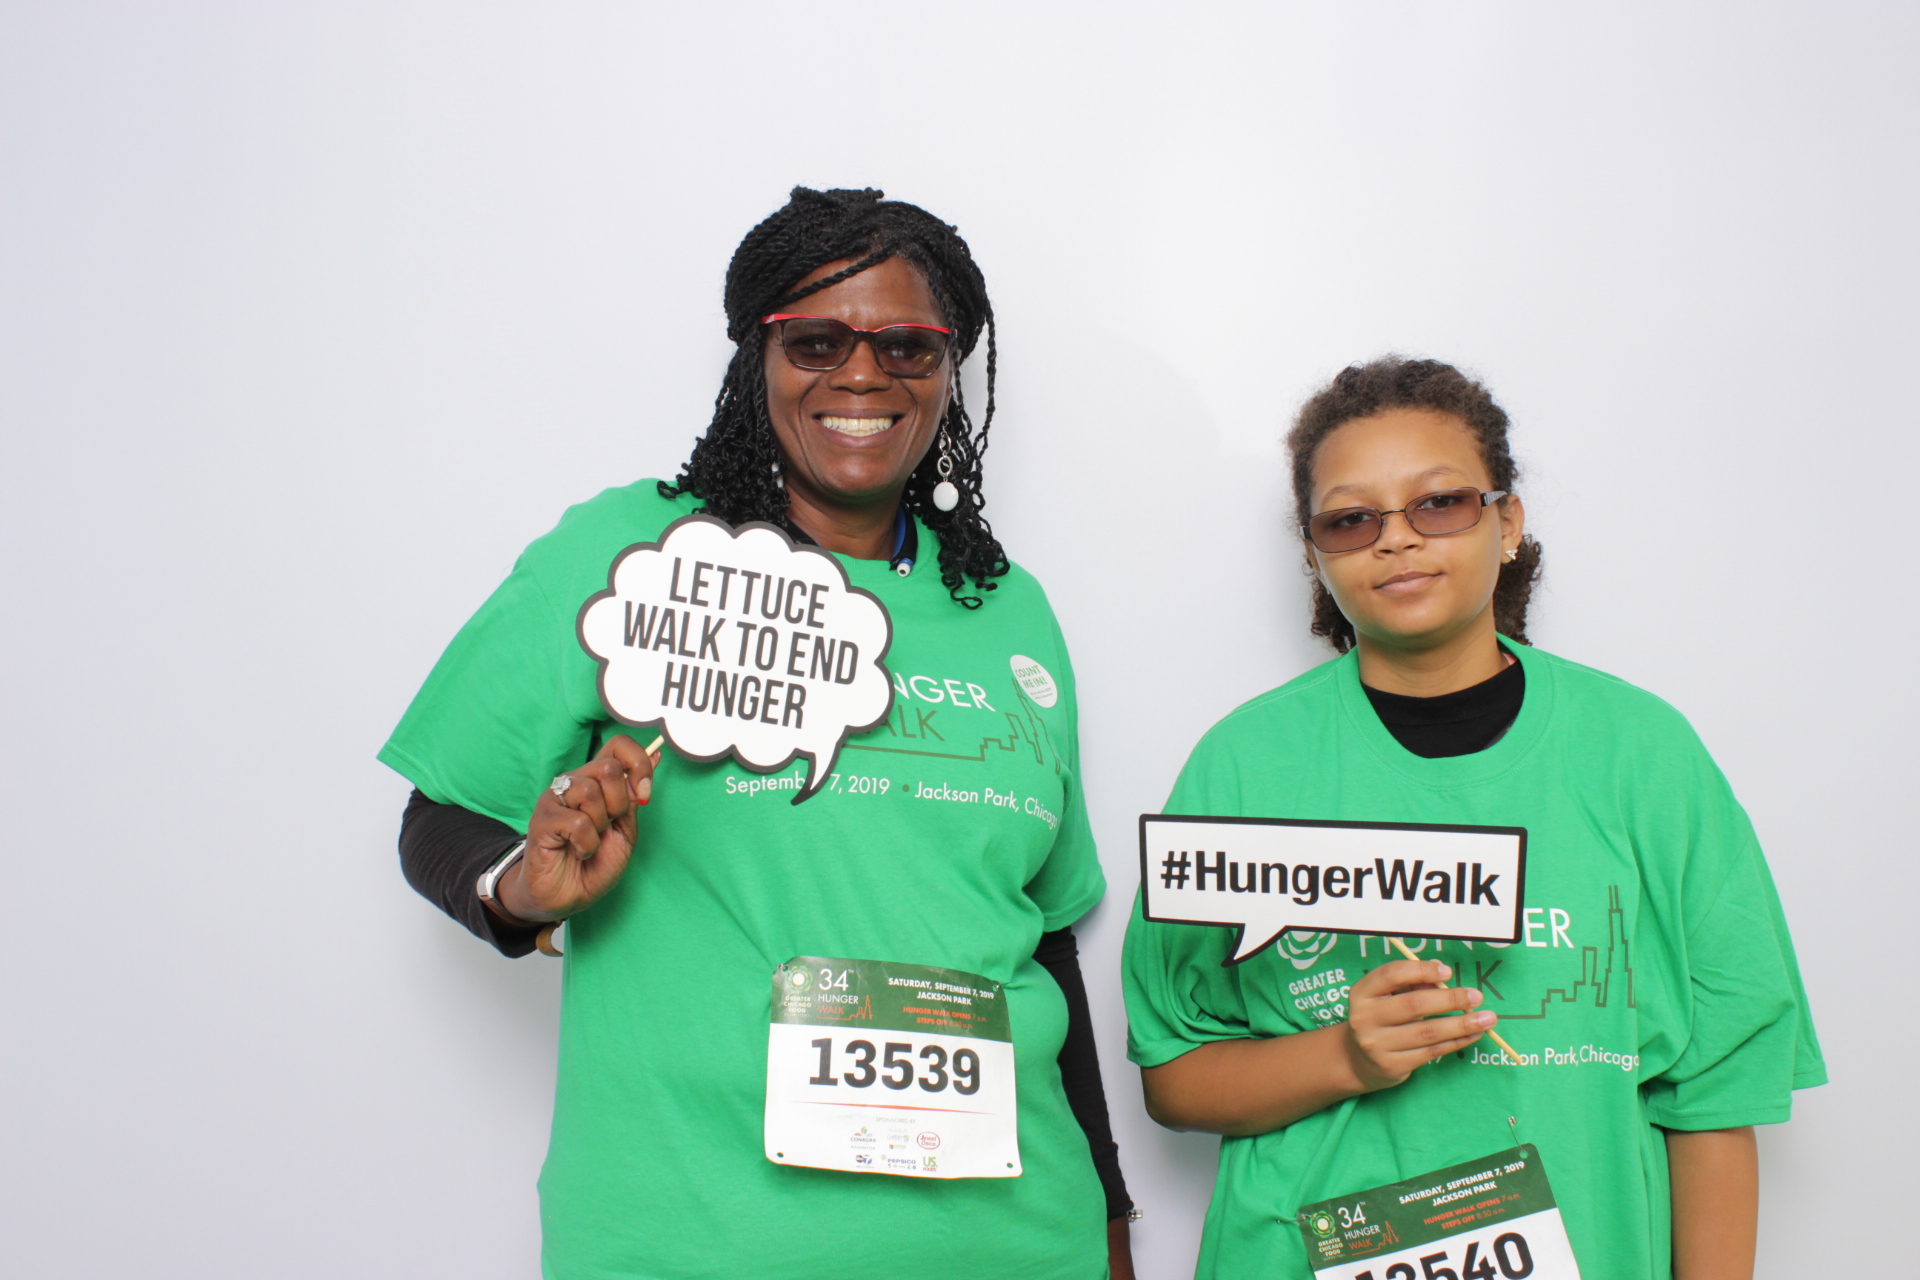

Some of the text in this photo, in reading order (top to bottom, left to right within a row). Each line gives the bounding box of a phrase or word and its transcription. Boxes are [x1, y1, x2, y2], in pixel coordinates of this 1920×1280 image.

[669, 557, 829, 629] LETTUCE
[623, 600, 859, 685] WALK TO END
[1014, 665, 1041, 678] COUNT
[661, 661, 807, 730] HUNGER
[893, 672, 996, 712] NGER
[725, 771, 1058, 830] Septemb 7, 2019 Jackson Park, Chicago
[1160, 850, 1501, 906] #HungerWalk
[888, 977, 994, 999] SATURDAY, SEPTEMBER 7, 2019
[1288, 968, 1346, 996] GREATER
[818, 994, 859, 1005] HUNGER
[917, 991, 972, 1005] JACKSON PARK
[1294, 985, 1351, 1010] CHICGO
[817, 1005, 845, 1015] WALK
[903, 1006, 932, 1015] HUNGER
[932, 1009, 951, 1017] WALK
[951, 1012, 972, 1020] OPENS
[916, 1017, 935, 1025] STEPS
[809, 1038, 980, 1096] 13539
[1544, 1046, 1579, 1067] Park,
[1398, 1161, 1525, 1205] SATURDAY, SEPTEMBER 7, 2019
[1432, 1181, 1498, 1207] JACKSON PARK
[1424, 1211, 1455, 1225] HUNGER
[1454, 1205, 1477, 1216] WALK
[1476, 1198, 1501, 1209] OPENS
[1441, 1218, 1462, 1230] STEPS
[1461, 1215, 1475, 1224] OFF
[1476, 1210, 1492, 1220] 8:30
[1318, 1237, 1341, 1247] GREATER
[1344, 1224, 1381, 1240] HUNGER
[1318, 1242, 1344, 1253] CHICAGO
[1325, 1249, 1341, 1257] FOOD
[1348, 1239, 1373, 1250] WALK
[1355, 1232, 1534, 1280] 540
